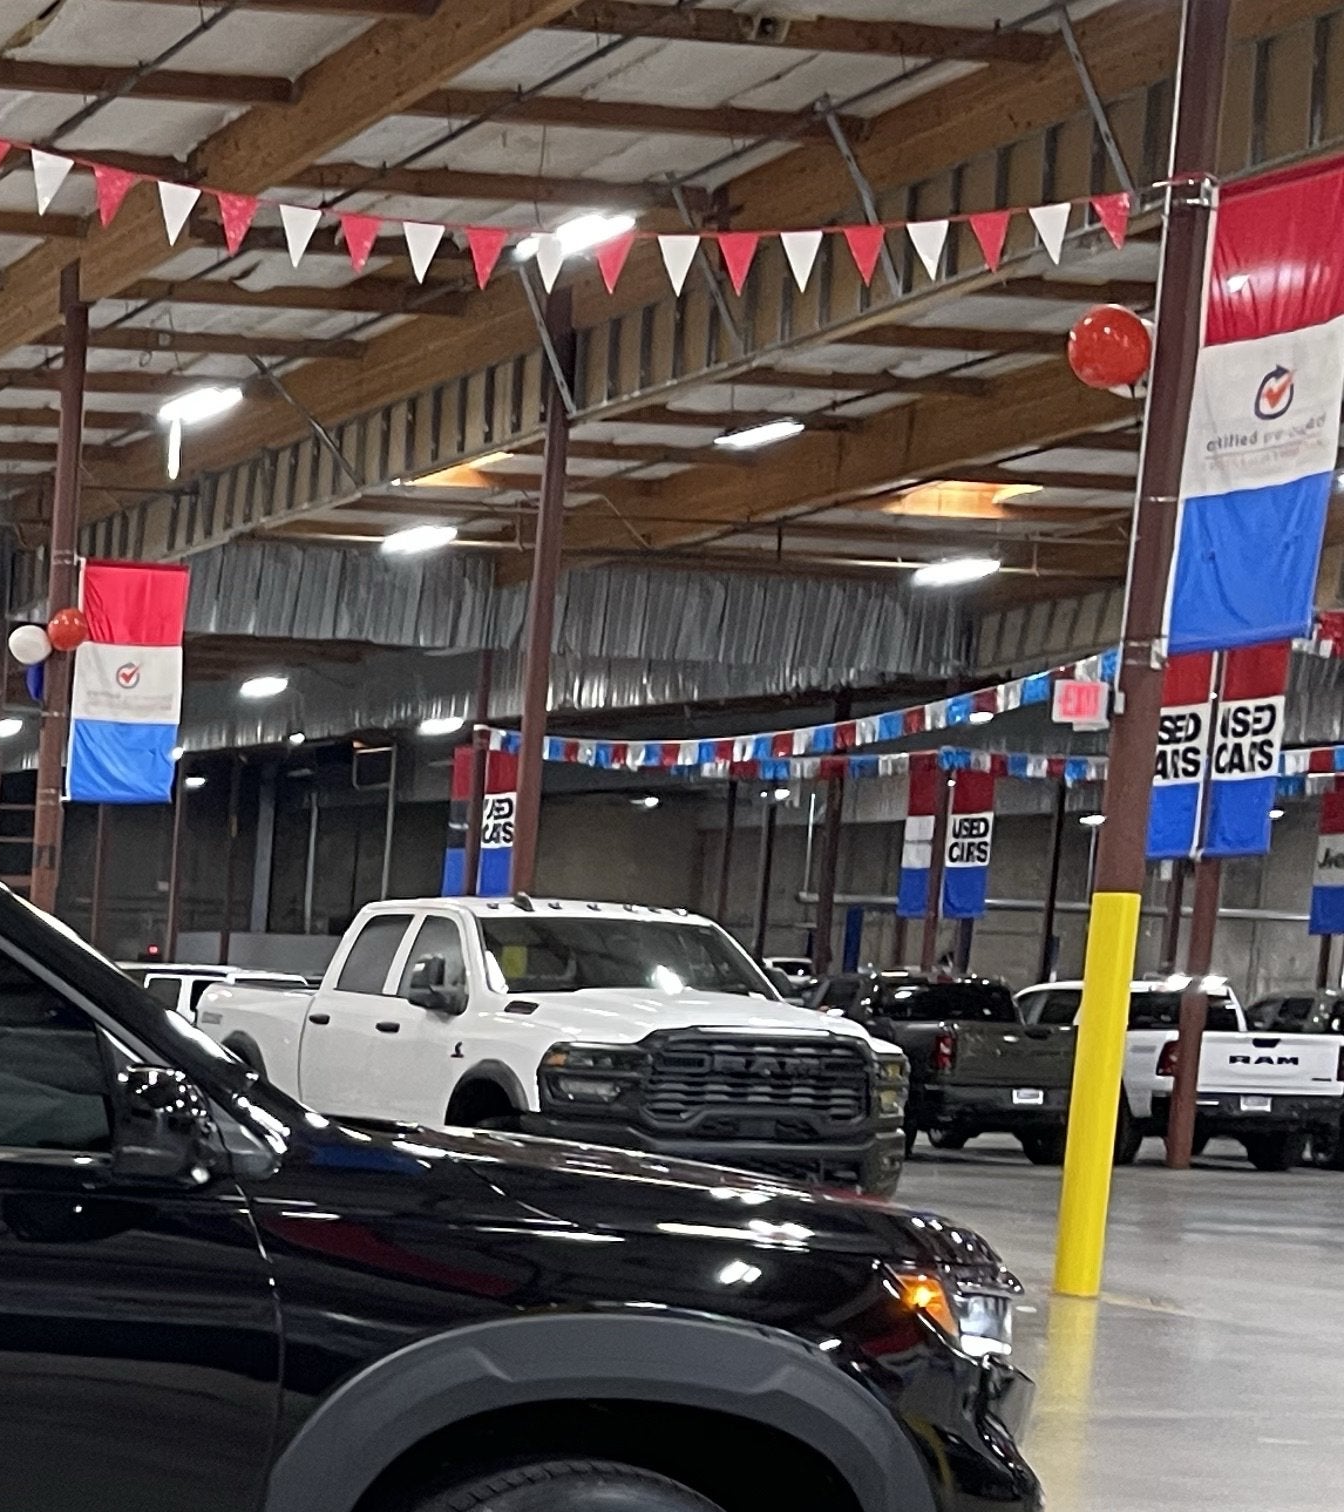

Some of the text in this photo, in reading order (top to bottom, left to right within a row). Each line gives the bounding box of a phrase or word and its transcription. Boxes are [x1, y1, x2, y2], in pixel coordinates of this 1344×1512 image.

[1158, 712, 1202, 745] SED
[1155, 746, 1201, 779] ARS
[952, 817, 990, 839] USED
[1229, 1055, 1299, 1066] RAM
